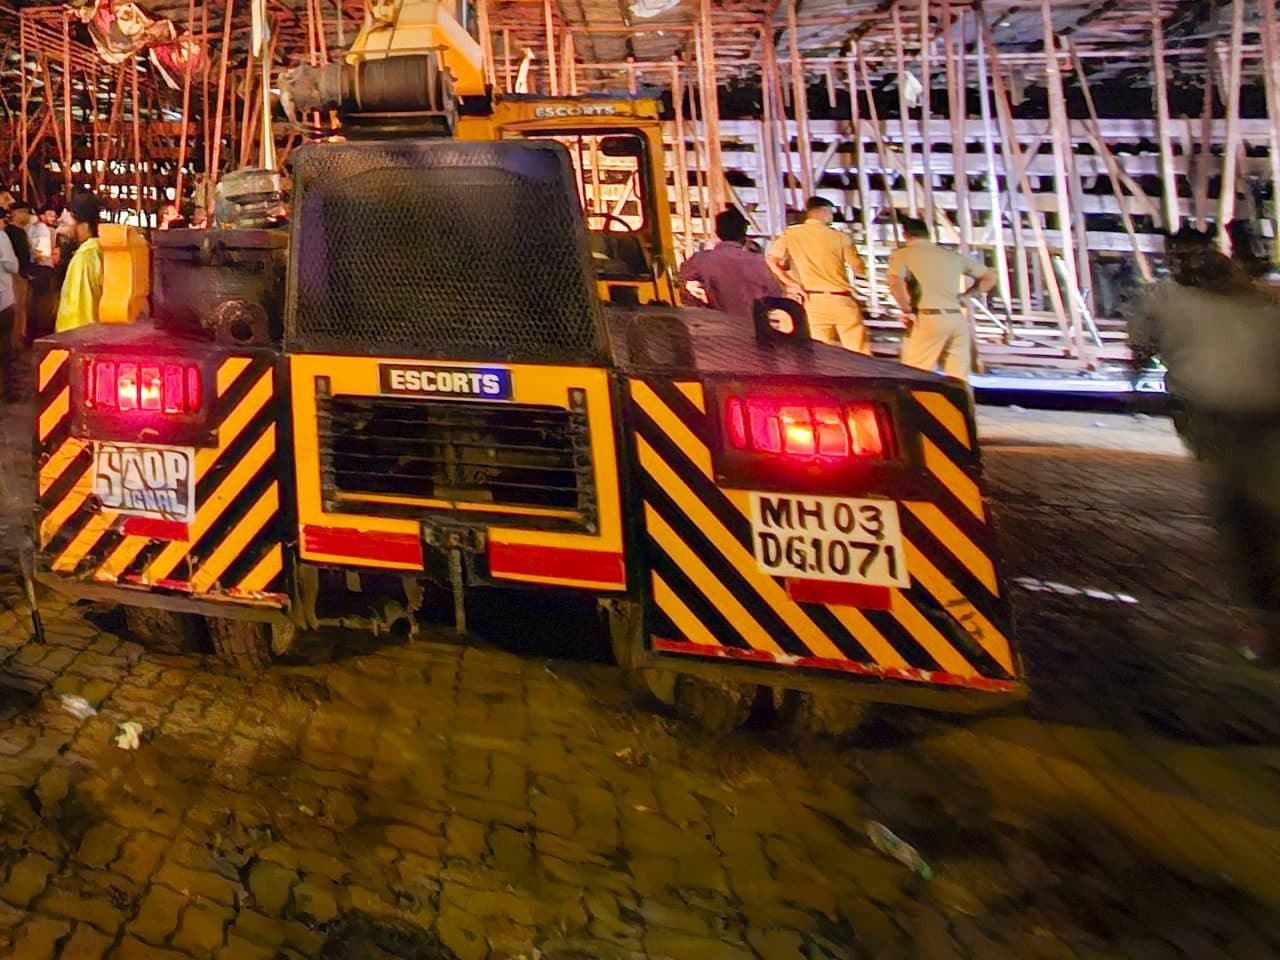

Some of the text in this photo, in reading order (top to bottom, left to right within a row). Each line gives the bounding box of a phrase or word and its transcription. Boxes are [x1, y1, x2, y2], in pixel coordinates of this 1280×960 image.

[535, 103, 616, 119] ESCORTS
[390, 369, 501, 395] ESCORTS
[759, 496, 885, 540] MH 03
